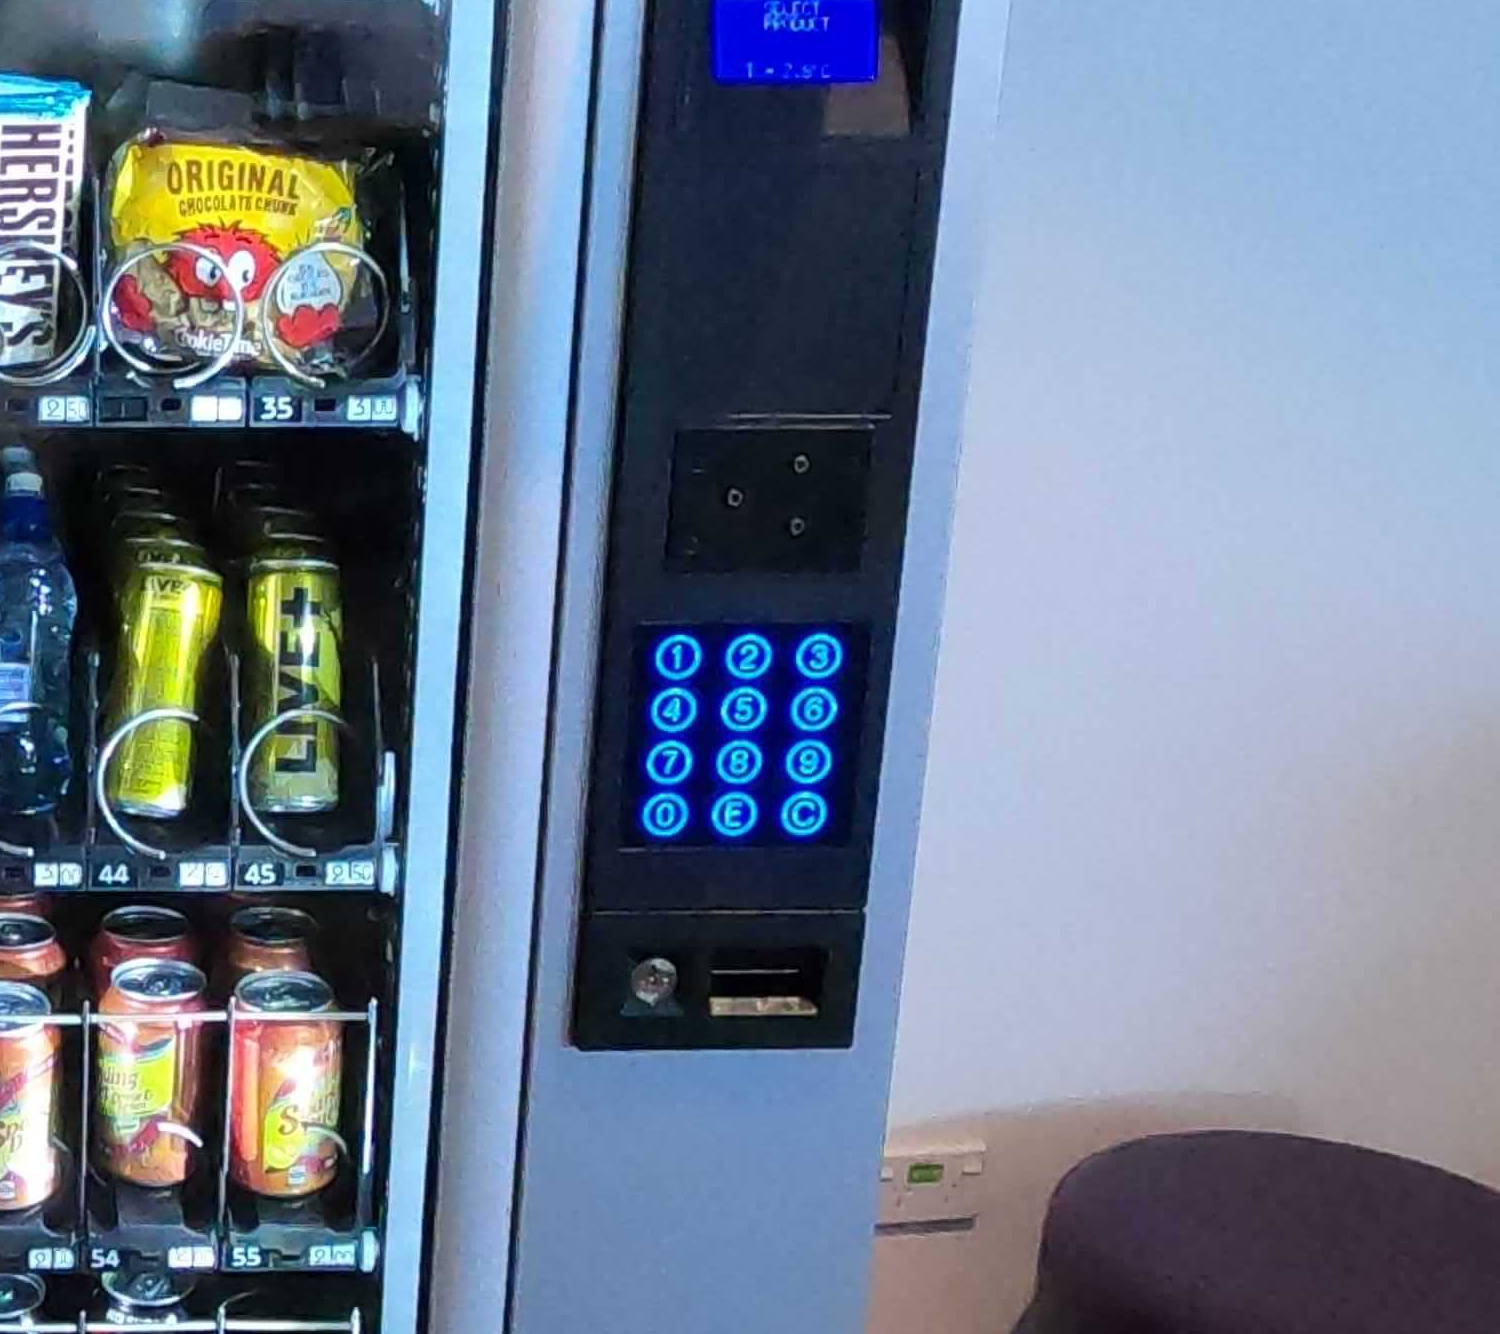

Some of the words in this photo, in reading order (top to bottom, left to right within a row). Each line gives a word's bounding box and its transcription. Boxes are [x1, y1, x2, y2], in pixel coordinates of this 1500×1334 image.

[166, 157, 302, 200] ORIGINAL
[178, 194, 252, 217] CHOCOLATE
[254, 196, 299, 217] CHUNK
[260, 396, 293, 419] 35
[670, 644, 683, 670] 1
[738, 644, 758, 670] 2
[809, 643, 829, 670] 3
[662, 697, 681, 722] 4
[734, 697, 754, 722] 5
[803, 696, 823, 722] 6
[661, 750, 679, 775] 7
[730, 749, 749, 775] 8
[800, 749, 820, 775] 9
[655, 802, 676, 828] 0
[723, 801, 743, 828] E
[791, 800, 816, 827] C
[97, 864, 130, 886] 44
[243, 864, 277, 886] 45
[90, 1249, 120, 1268] 54
[231, 1248, 261, 1267] 55
